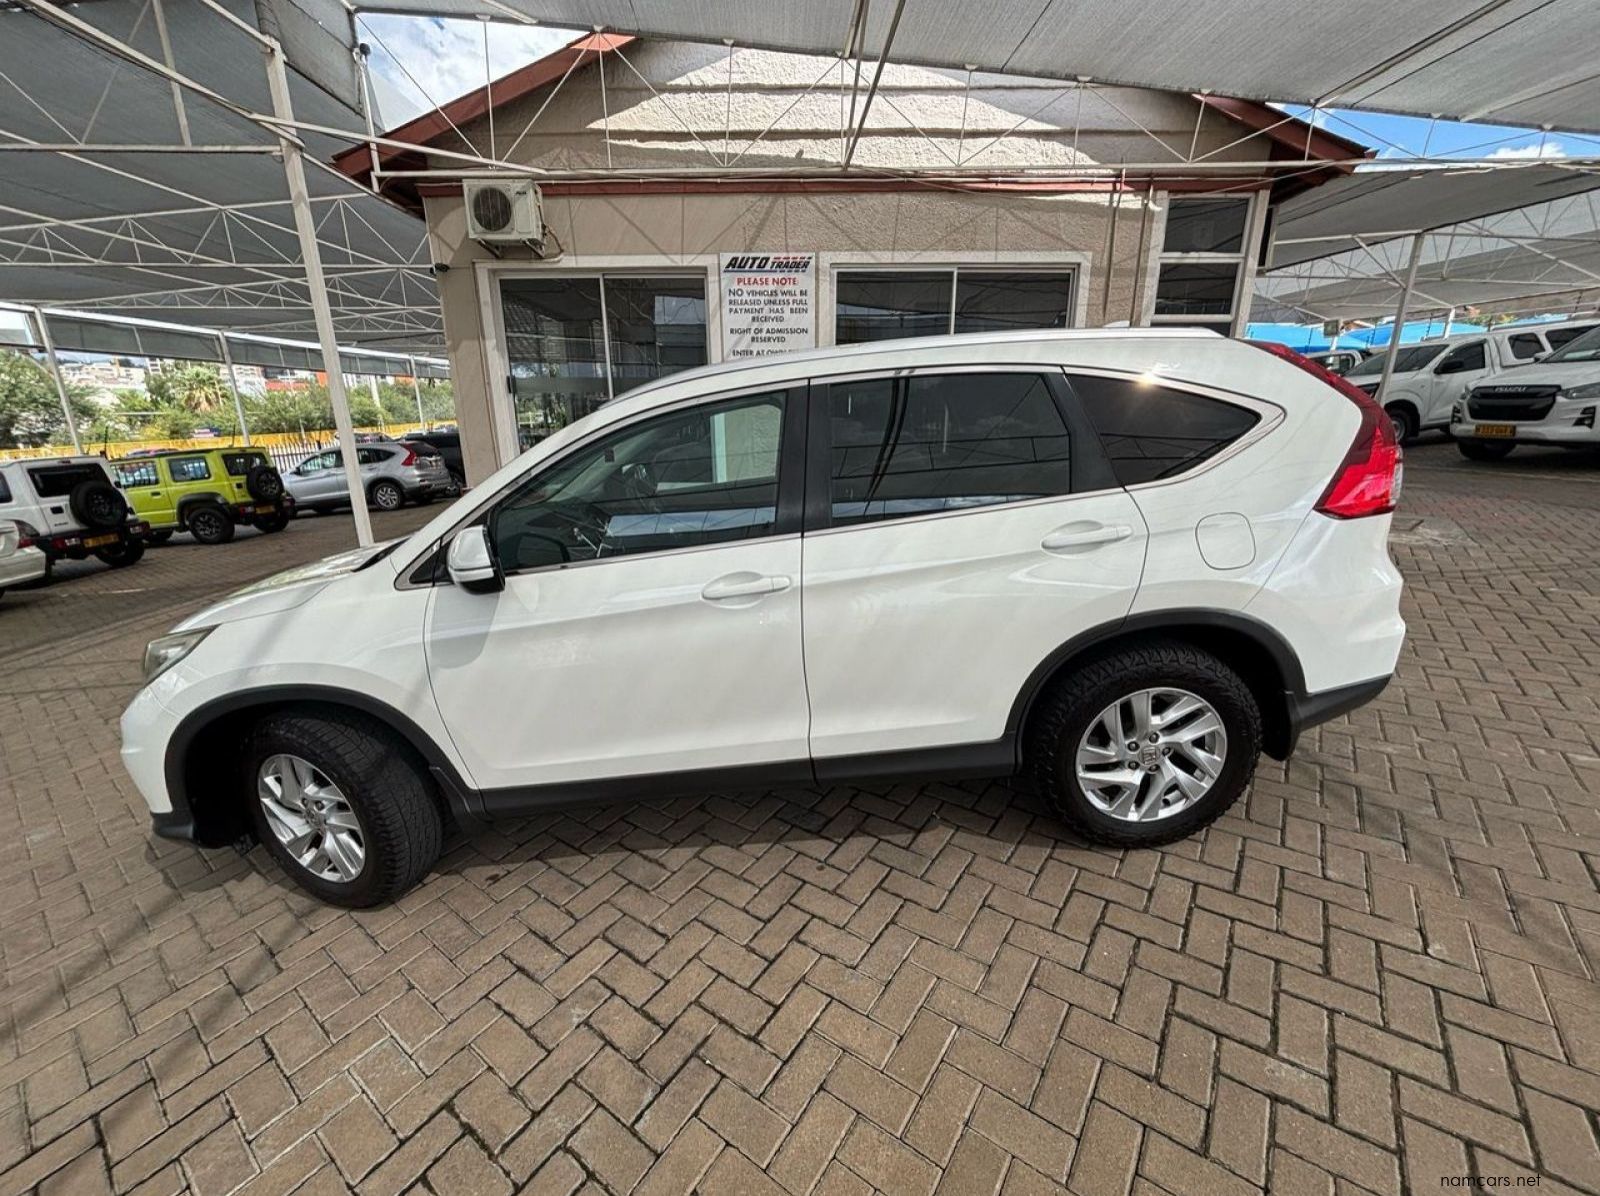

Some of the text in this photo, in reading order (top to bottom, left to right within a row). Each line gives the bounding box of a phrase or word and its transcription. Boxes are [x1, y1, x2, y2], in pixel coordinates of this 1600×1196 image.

[725, 256, 811, 269] AUTO TRADER
[737, 277, 769, 286] PLEASE
[728, 288, 808, 297] NO VEHICLES WILL BE
[765, 327, 808, 335] ADMISSION
[732, 349, 754, 357] ENTER
[755, 349, 765, 357] AT
